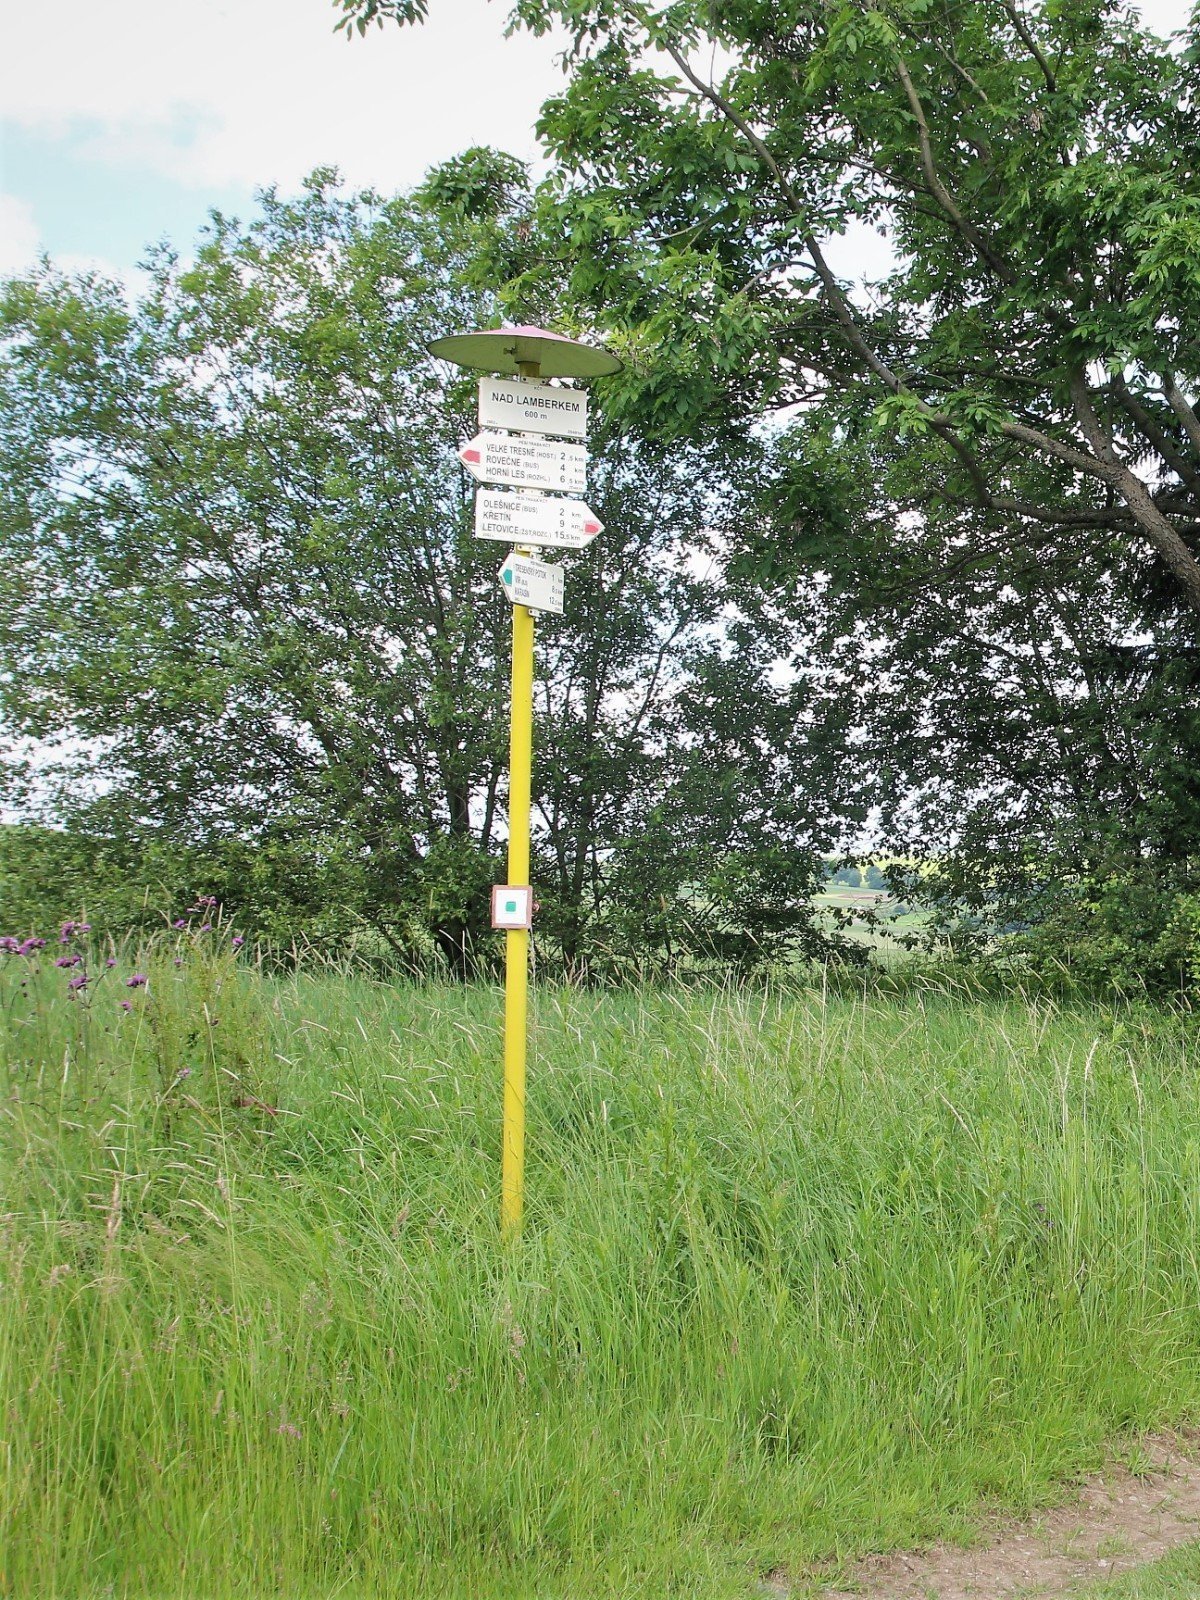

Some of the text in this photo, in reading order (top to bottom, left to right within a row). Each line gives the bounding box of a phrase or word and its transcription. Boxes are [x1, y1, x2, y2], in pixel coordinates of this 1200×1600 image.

[492, 392, 580, 412] NAD LAMBERKEM
[524, 410, 538, 419] 600
[522, 461, 539, 470] (BUS)
[560, 463, 566, 471] 4
[511, 469, 526, 479] LES
[483, 498, 521, 511] OLEŠNICE
[559, 507, 565, 517] 2
[559, 519, 565, 528] 9
[482, 523, 519, 535] LETOVICE
